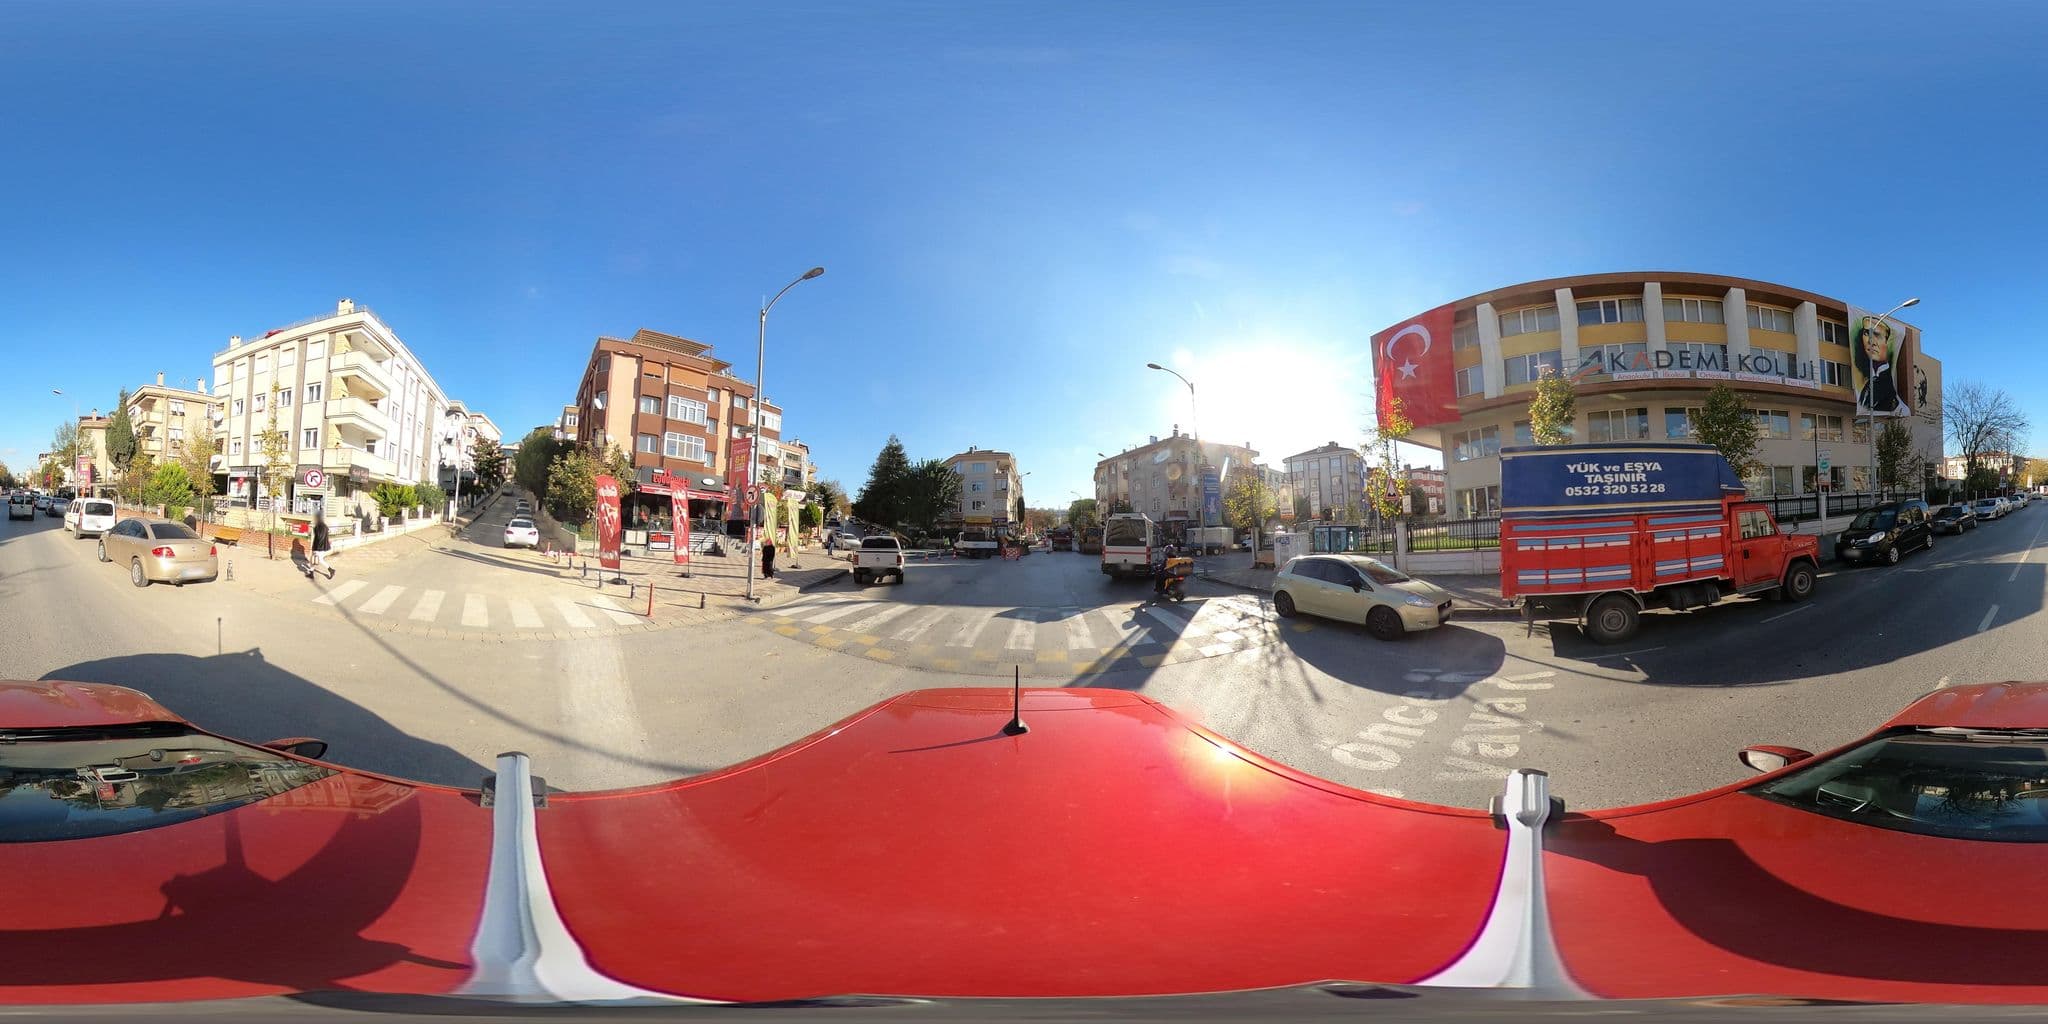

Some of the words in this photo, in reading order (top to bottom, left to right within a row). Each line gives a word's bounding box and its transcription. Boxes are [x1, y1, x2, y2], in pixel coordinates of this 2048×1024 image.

[1566, 462, 1600, 473] YÜK
[1624, 462, 1662, 474] EŞYA
[1584, 473, 1647, 485] TAŞINIR
[1565, 486, 1600, 496] 0532
[1603, 485, 1628, 495] 320
